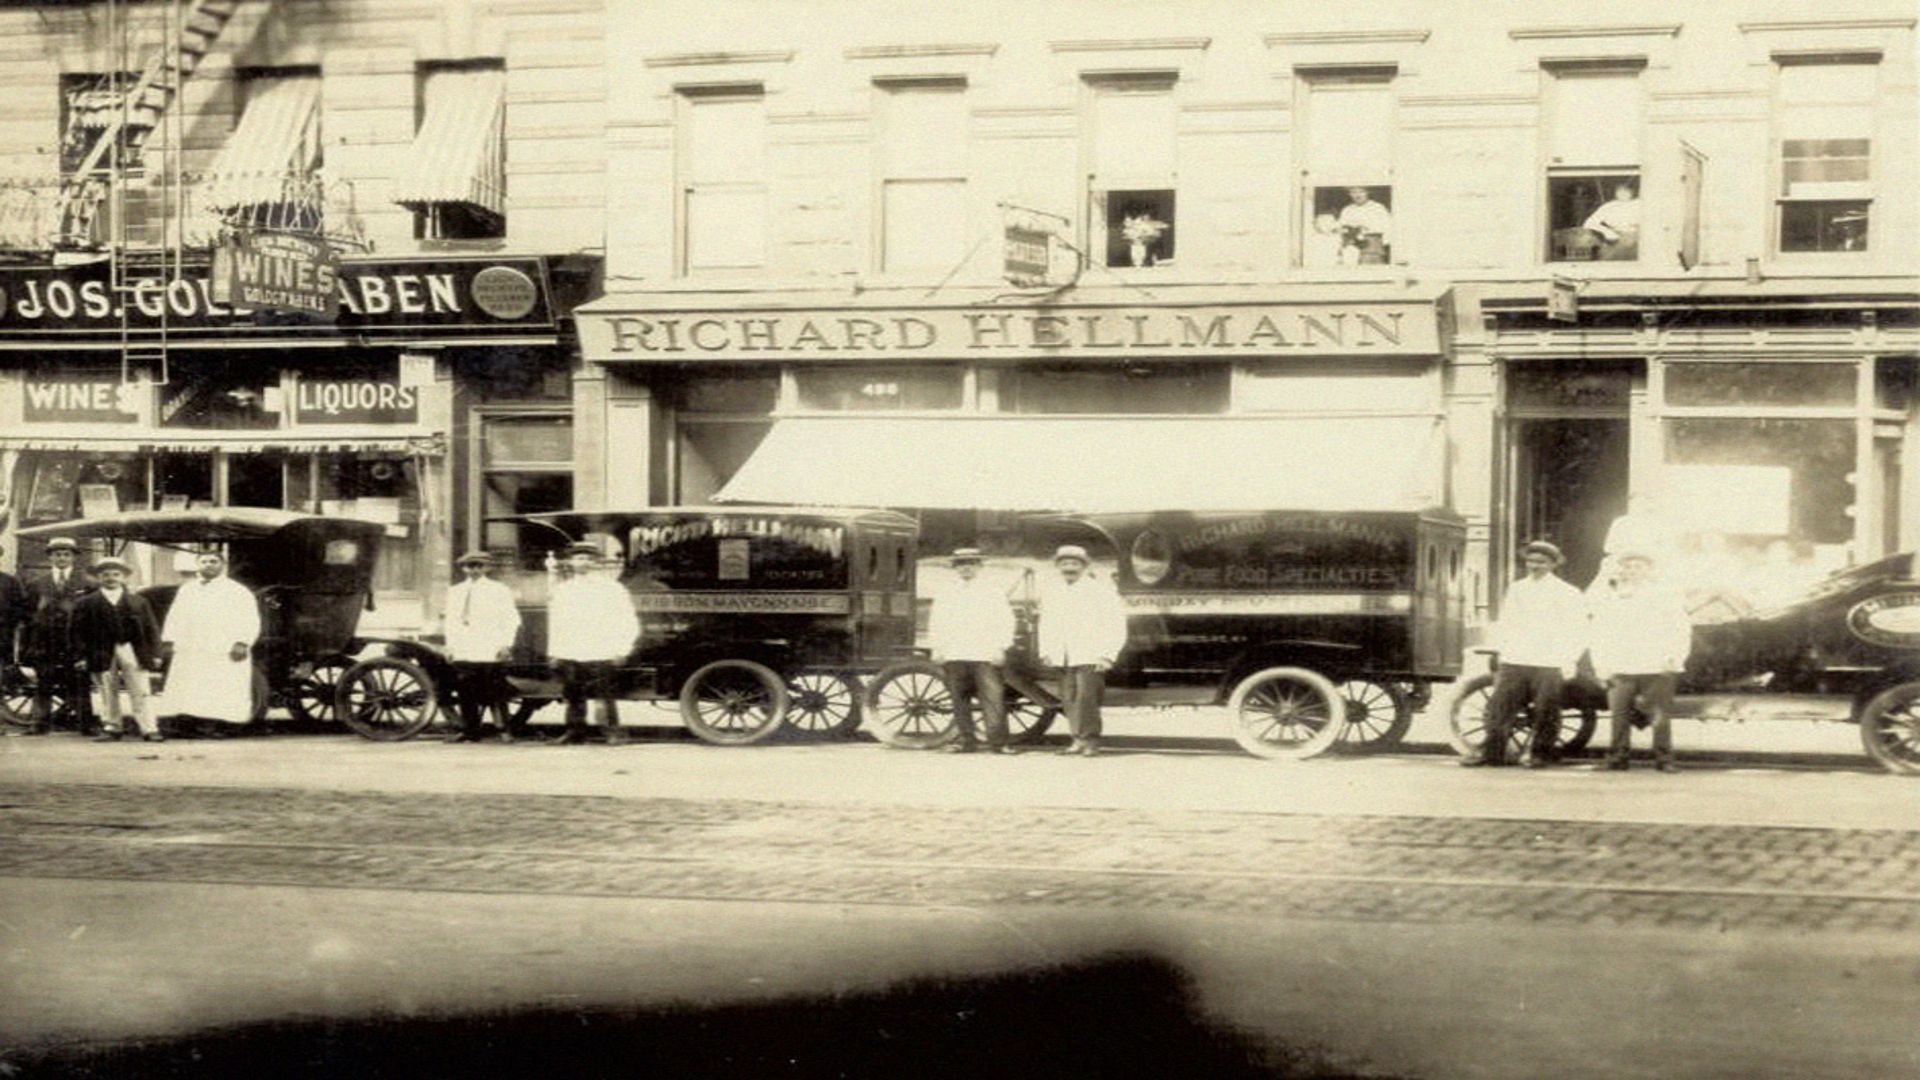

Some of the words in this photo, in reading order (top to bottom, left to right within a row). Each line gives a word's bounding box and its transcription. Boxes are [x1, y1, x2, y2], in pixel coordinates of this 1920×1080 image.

[235, 250, 334, 294] WINES
[17, 280, 124, 318] JOS.
[605, 317, 937, 353] RICHARD
[963, 312, 1404, 349] HELLMANN
[300, 383, 415, 415] LIQUORS
